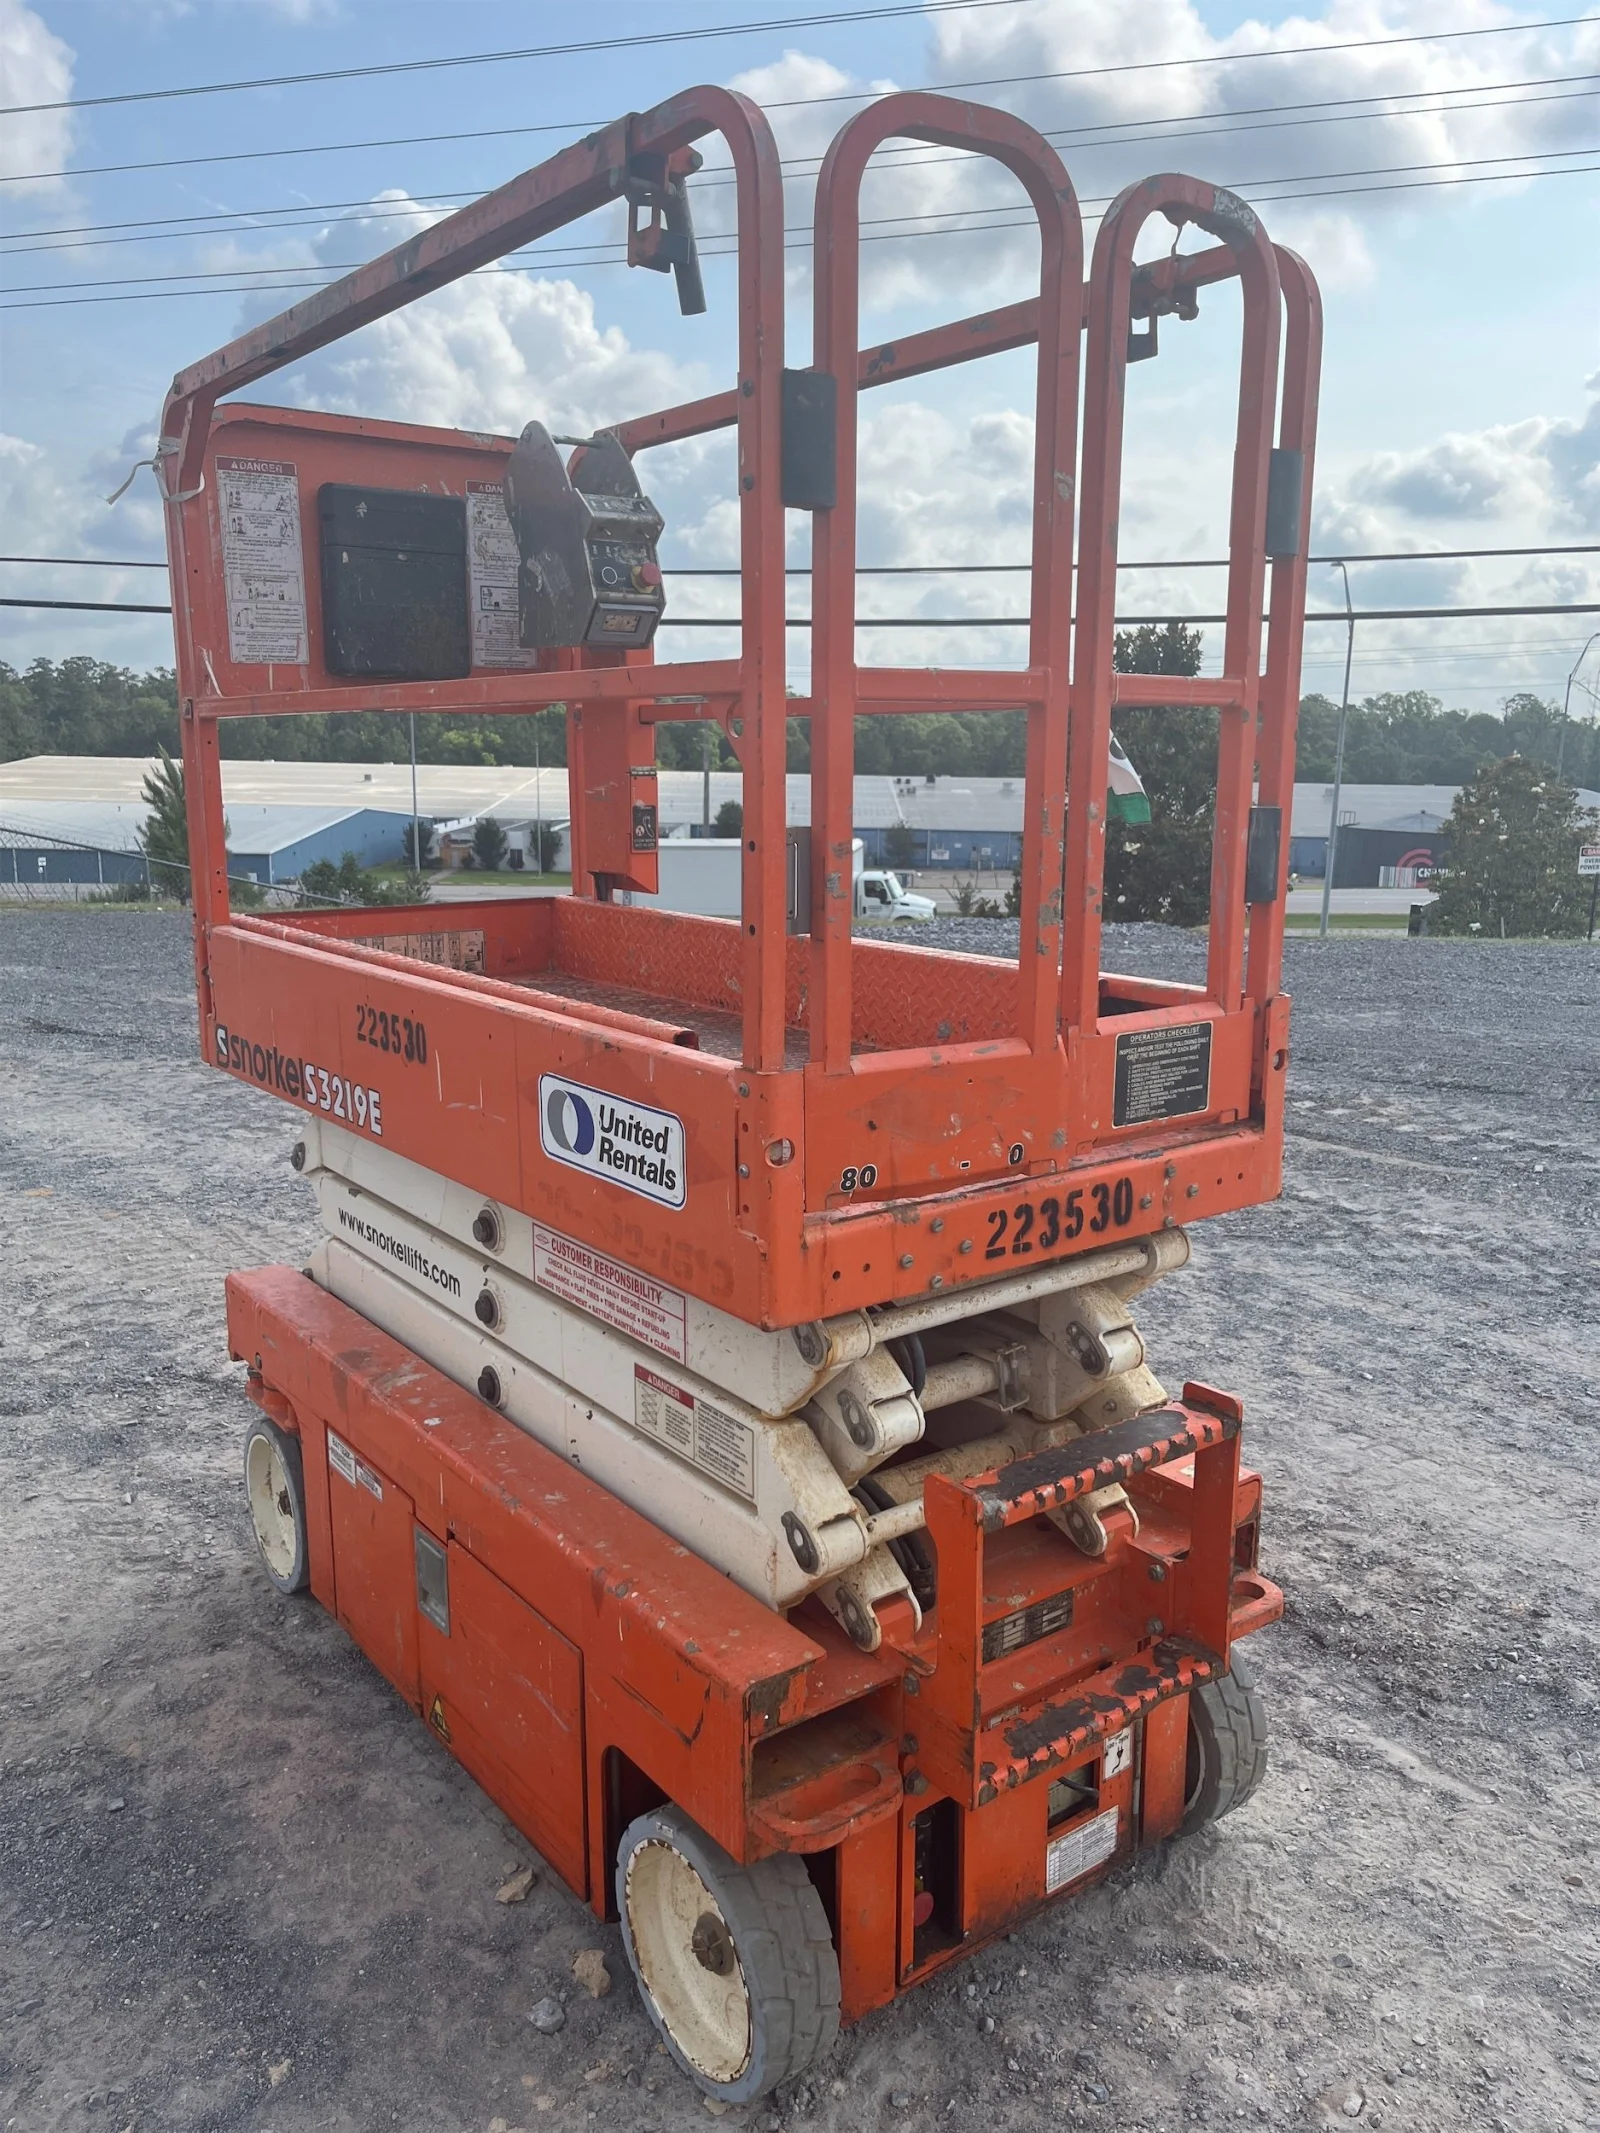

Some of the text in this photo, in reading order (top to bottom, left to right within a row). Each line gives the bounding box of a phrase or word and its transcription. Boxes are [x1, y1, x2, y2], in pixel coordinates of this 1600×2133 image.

[240, 461, 282, 473] DANGER
[485, 484, 503, 493] DAN
[357, 1004, 427, 1065] 223530
[1130, 1026, 1199, 1042] OPERATORS CHECKLIST
[230, 1034, 306, 1101] snorkel
[304, 1063, 383, 1137] S3219E
[599, 1104, 669, 1155] United
[599, 1136, 677, 1190] Rentals
[985, 1177, 1133, 1260] 223530
[338, 1207, 461, 1298] www.snorkellifts.com
[552, 1237, 591, 1270] CUSTOMER
[594, 1258, 661, 1305] RESPONSIBILITY
[537, 1274, 553, 1289] DAMAGE
[562, 1288, 587, 1308] EQUIPMENT
[592, 1305, 612, 1322] BATTERY
[614, 1316, 648, 1342] MAINTENANCE
[654, 1338, 679, 1359] CLEANING
[545, 1266, 670, 1340] INSURANCE FLAT TIRES TIRE DAMAGE REFUELING
[548, 1256, 665, 1324] CHECK ALL FLUID LEVELS DAILY BEFORE START-UP
[653, 1378, 680, 1400] DANGER
